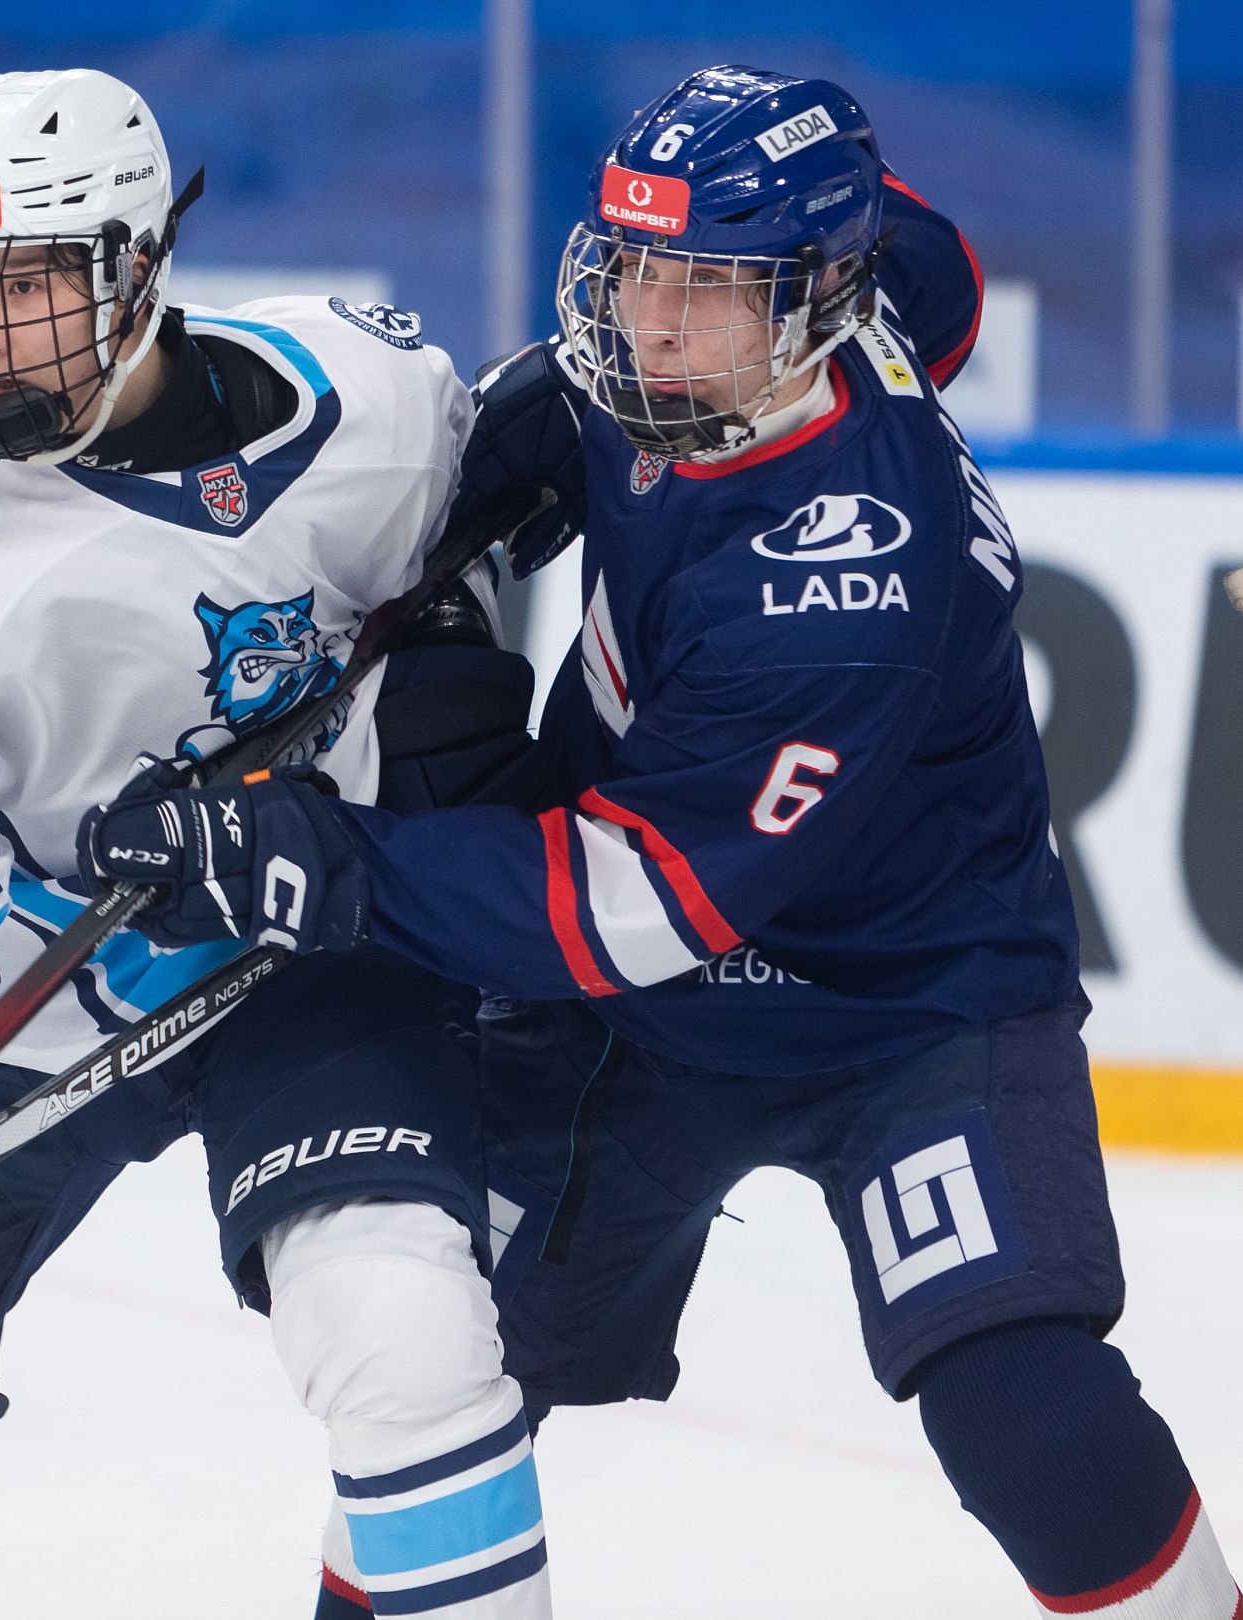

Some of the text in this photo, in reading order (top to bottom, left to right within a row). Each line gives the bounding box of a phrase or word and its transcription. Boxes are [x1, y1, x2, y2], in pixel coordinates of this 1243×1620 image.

[650, 123, 695, 162] 6
[766, 113, 831, 154] LADA
[114, 165, 155, 186] BAUER
[604, 203, 679, 231] OLIMPBET
[805, 185, 854, 215] BAUER
[204, 475, 237, 492] МХЛ
[530, 522, 571, 570] CCM
[762, 572, 910, 616] LADA
[748, 740, 842, 835] 6
[218, 797, 243, 849] XF
[109, 846, 170, 866] CCM
[39, 1055, 113, 1132] ACE
[120, 995, 207, 1078] prime
[224, 1126, 433, 1217] BAUER
